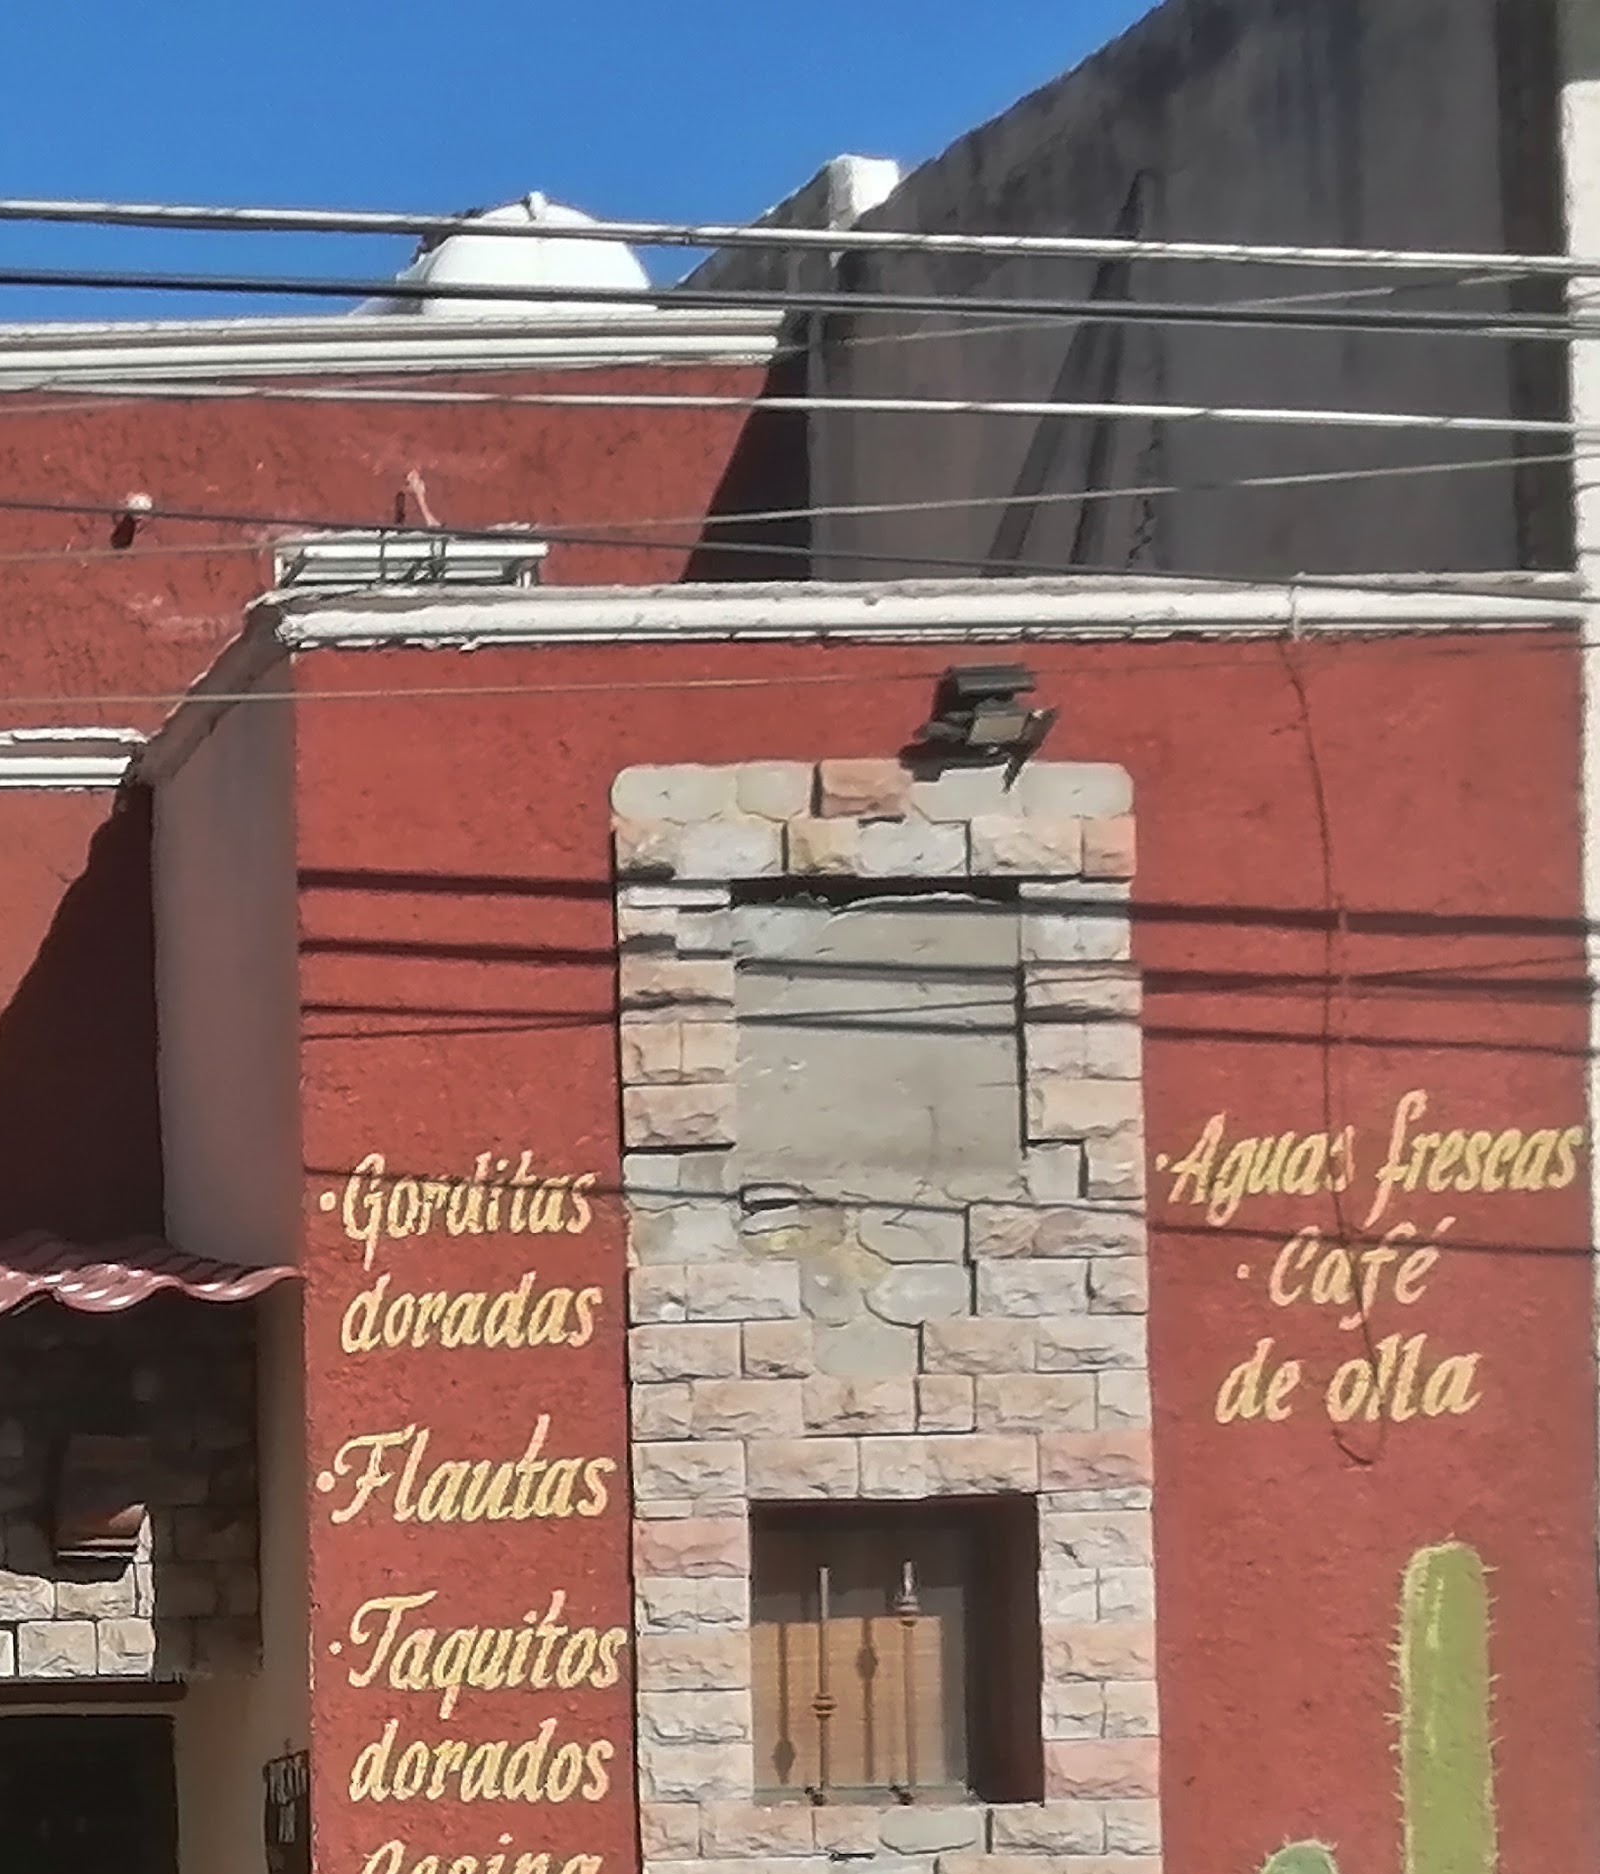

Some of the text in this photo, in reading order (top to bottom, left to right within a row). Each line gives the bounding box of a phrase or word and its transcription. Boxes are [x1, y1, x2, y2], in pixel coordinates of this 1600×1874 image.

[341, 1152, 601, 1271] Gorditas
[1166, 1088, 1586, 1230] Aguas frescas
[340, 1270, 603, 1354] doradas
[1268, 1215, 1457, 1331] Café
[1214, 1332, 1484, 1425] de olla
[330, 1412, 618, 1524] Flautas
[348, 1589, 629, 1720] Taquitos
[348, 1718, 615, 1803] dorados
